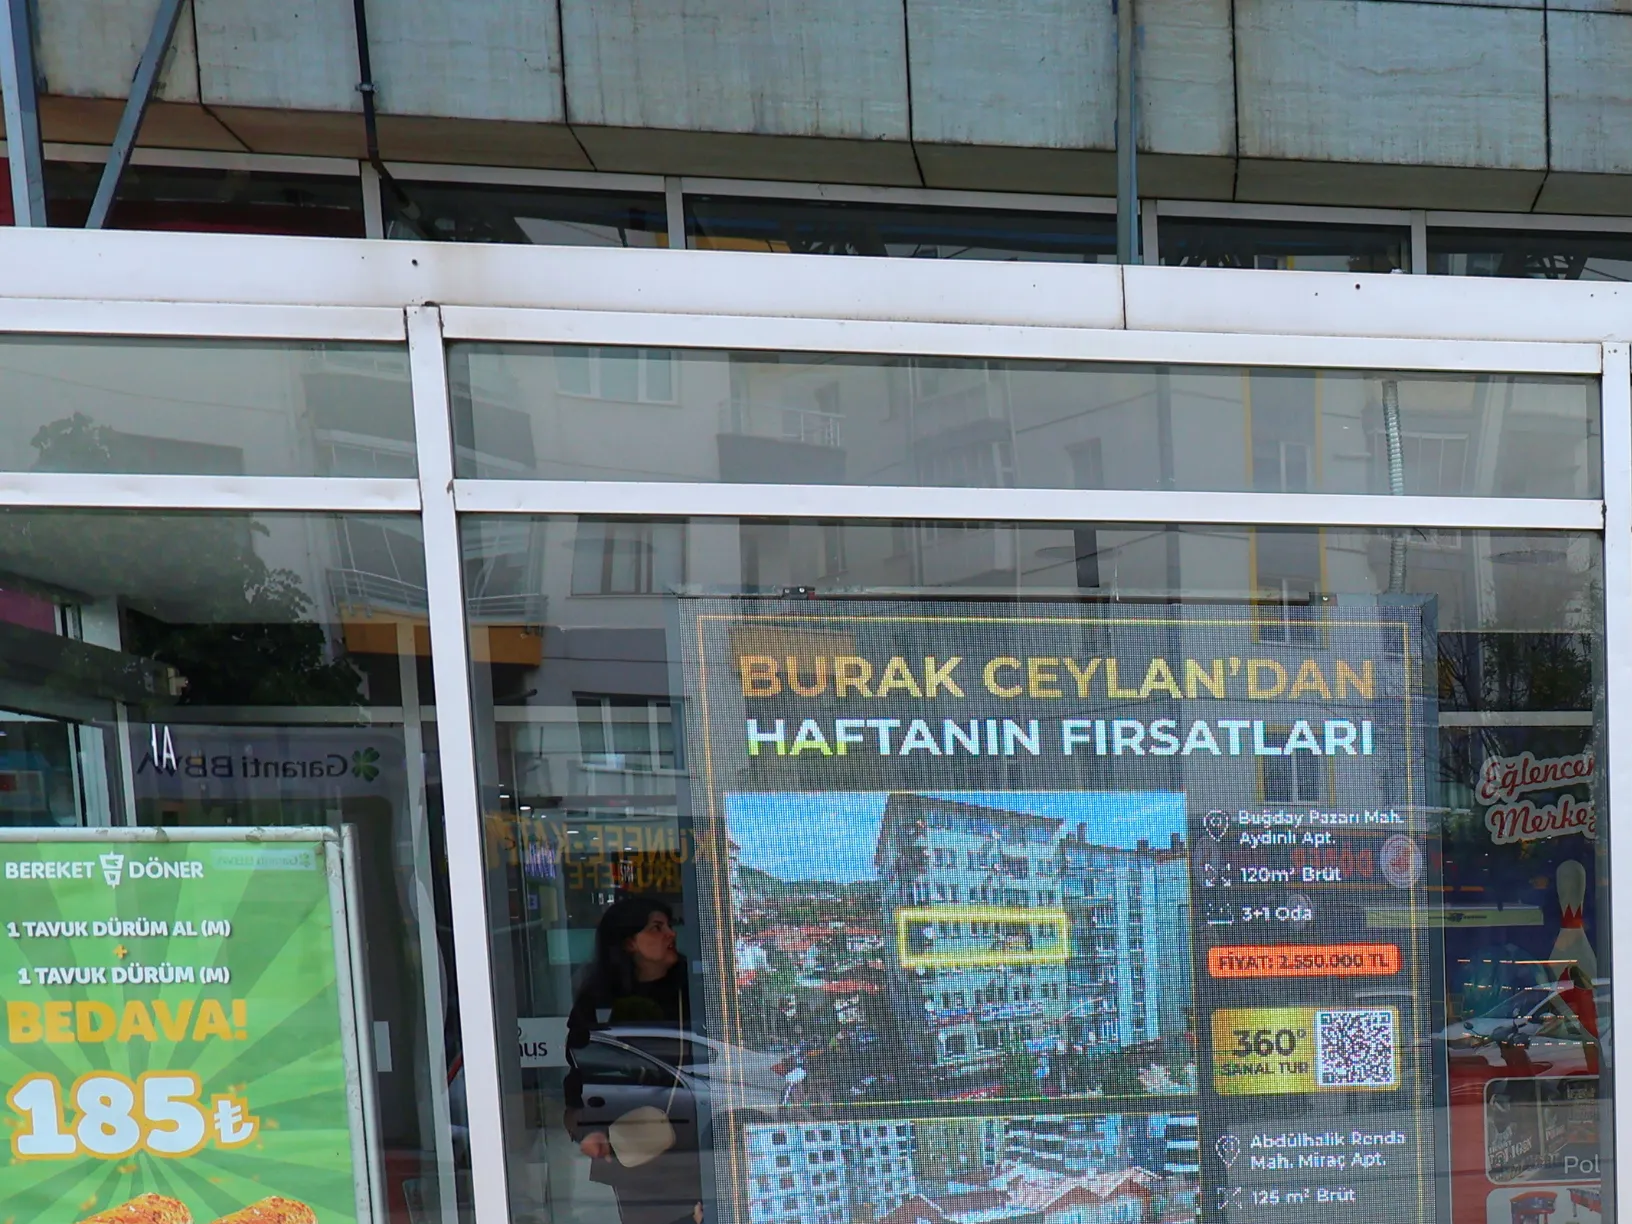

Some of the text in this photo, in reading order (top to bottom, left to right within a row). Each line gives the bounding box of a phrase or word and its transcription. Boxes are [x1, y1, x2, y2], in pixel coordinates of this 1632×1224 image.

[740, 655, 1376, 699] BURAK CEYLAN'DAN
[747, 717, 1376, 757] HAFTANIN FIRSATLARI
[1238, 808, 1405, 828] Buğday Pazarı Mah.
[1239, 829, 1337, 849] Aydınlı Apt.
[5, 861, 95, 879] BEREKET
[129, 857, 205, 879] DÖNER
[1302, 865, 1342, 882] Brüt
[1241, 904, 1313, 922] 3+1 Oda
[7, 917, 232, 938] 1 TAVUK DÜRÜM AL (M)
[1369, 953, 1390, 968] TL
[18, 962, 231, 985] 1 TAVUK DÜRÜM (M)
[6, 999, 248, 1044] BEDAVA!
[1279, 1061, 1309, 1075] TUR
[1250, 1132, 1345, 1149] Abdülhalik
[1250, 1154, 1294, 1170] Mah.
[1351, 1151, 1387, 1168] Apt.
[1252, 1190, 1280, 1206] 125
[1317, 1187, 1357, 1203] Brüt
